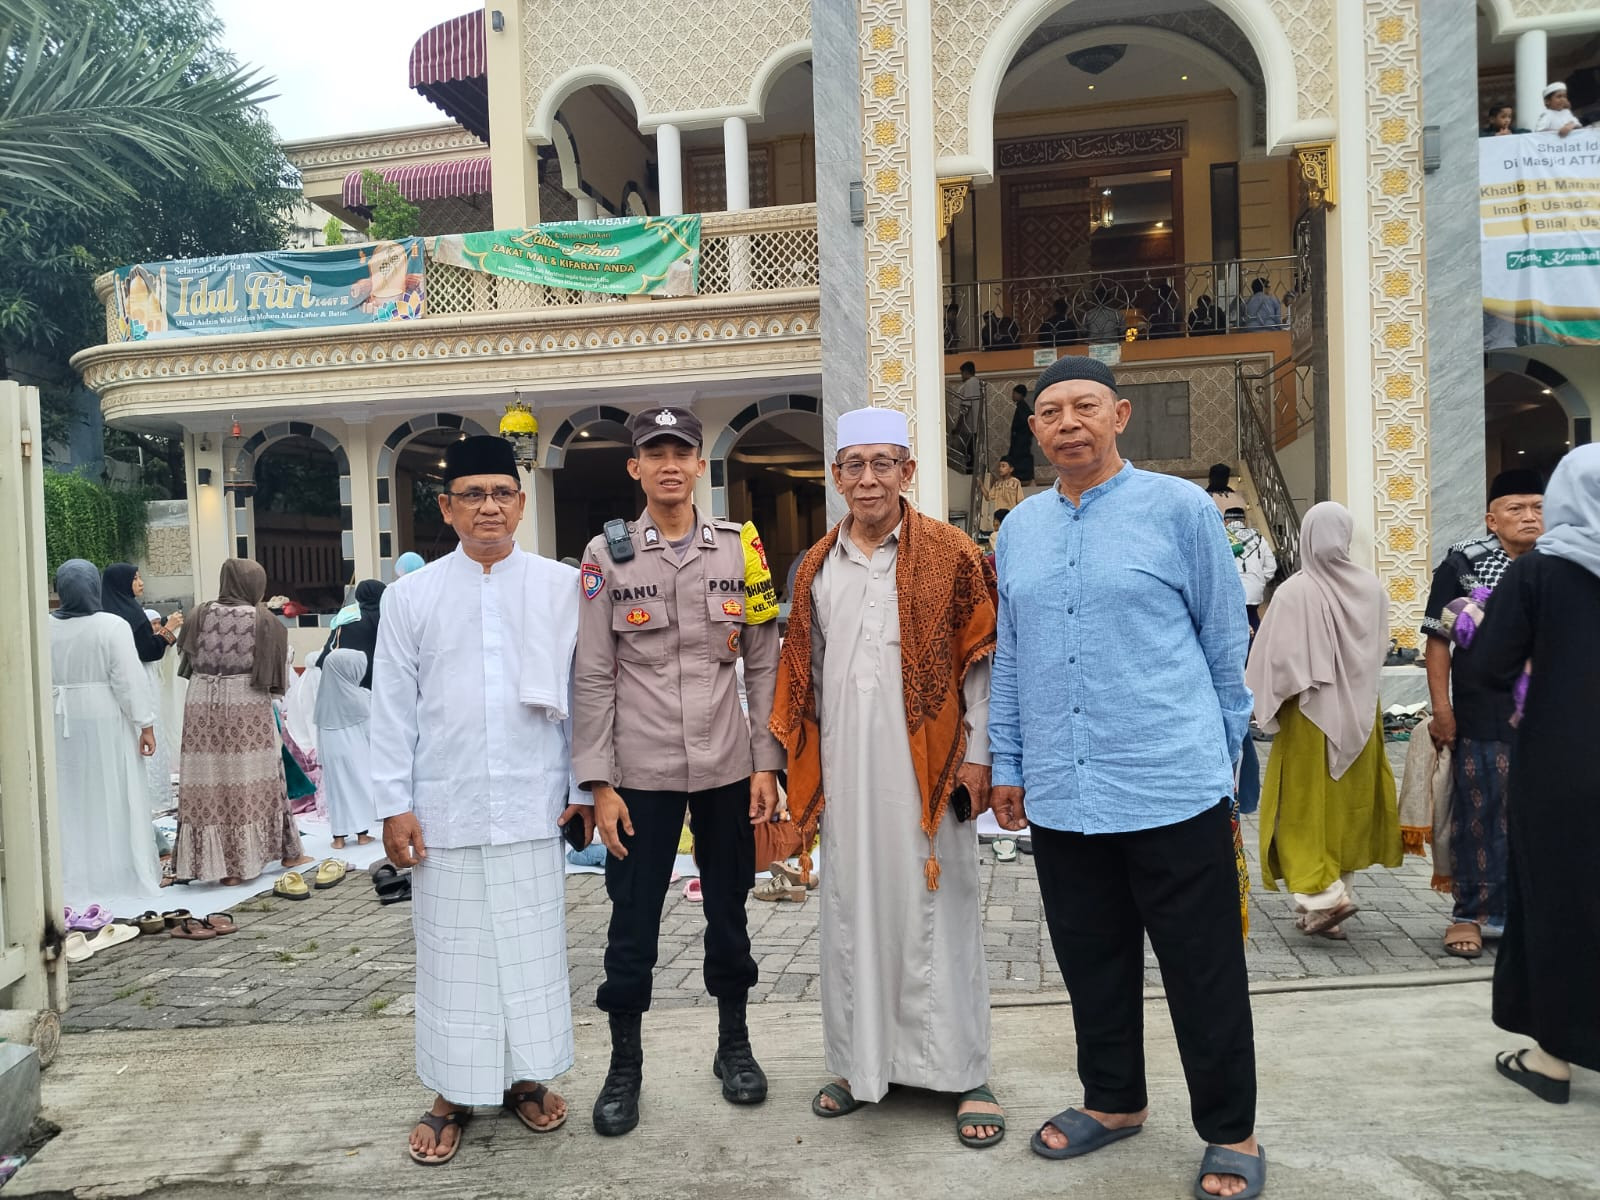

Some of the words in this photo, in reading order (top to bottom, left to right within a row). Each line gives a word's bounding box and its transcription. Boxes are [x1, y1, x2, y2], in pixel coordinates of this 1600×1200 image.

[1537, 143, 1581, 153] Shalat
[1585, 140, 1600, 152] Id
[1503, 158, 1519, 170] Di
[1522, 156, 1566, 168] Masjid
[1480, 183, 1526, 198] Khatib
[1493, 202, 1531, 216] Imam
[1535, 217, 1568, 230] Bilal
[1580, 217, 1600, 229] Us
[492, 243, 524, 258] ZAKAT
[525, 250, 549, 264] MAL
[550, 256, 558, 266] &
[559, 259, 601, 272] KIFARAT
[603, 263, 636, 273] ANDA
[1544, 249, 1600, 266] Kembal
[174, 265, 207, 276] Selamat
[209, 263, 229, 273] Hari
[230, 262, 251, 273] Raya
[173, 274, 239, 316] Idul
[245, 271, 315, 309] Fitri
[613, 584, 658, 601] DANU
[709, 580, 745, 592] POLR
